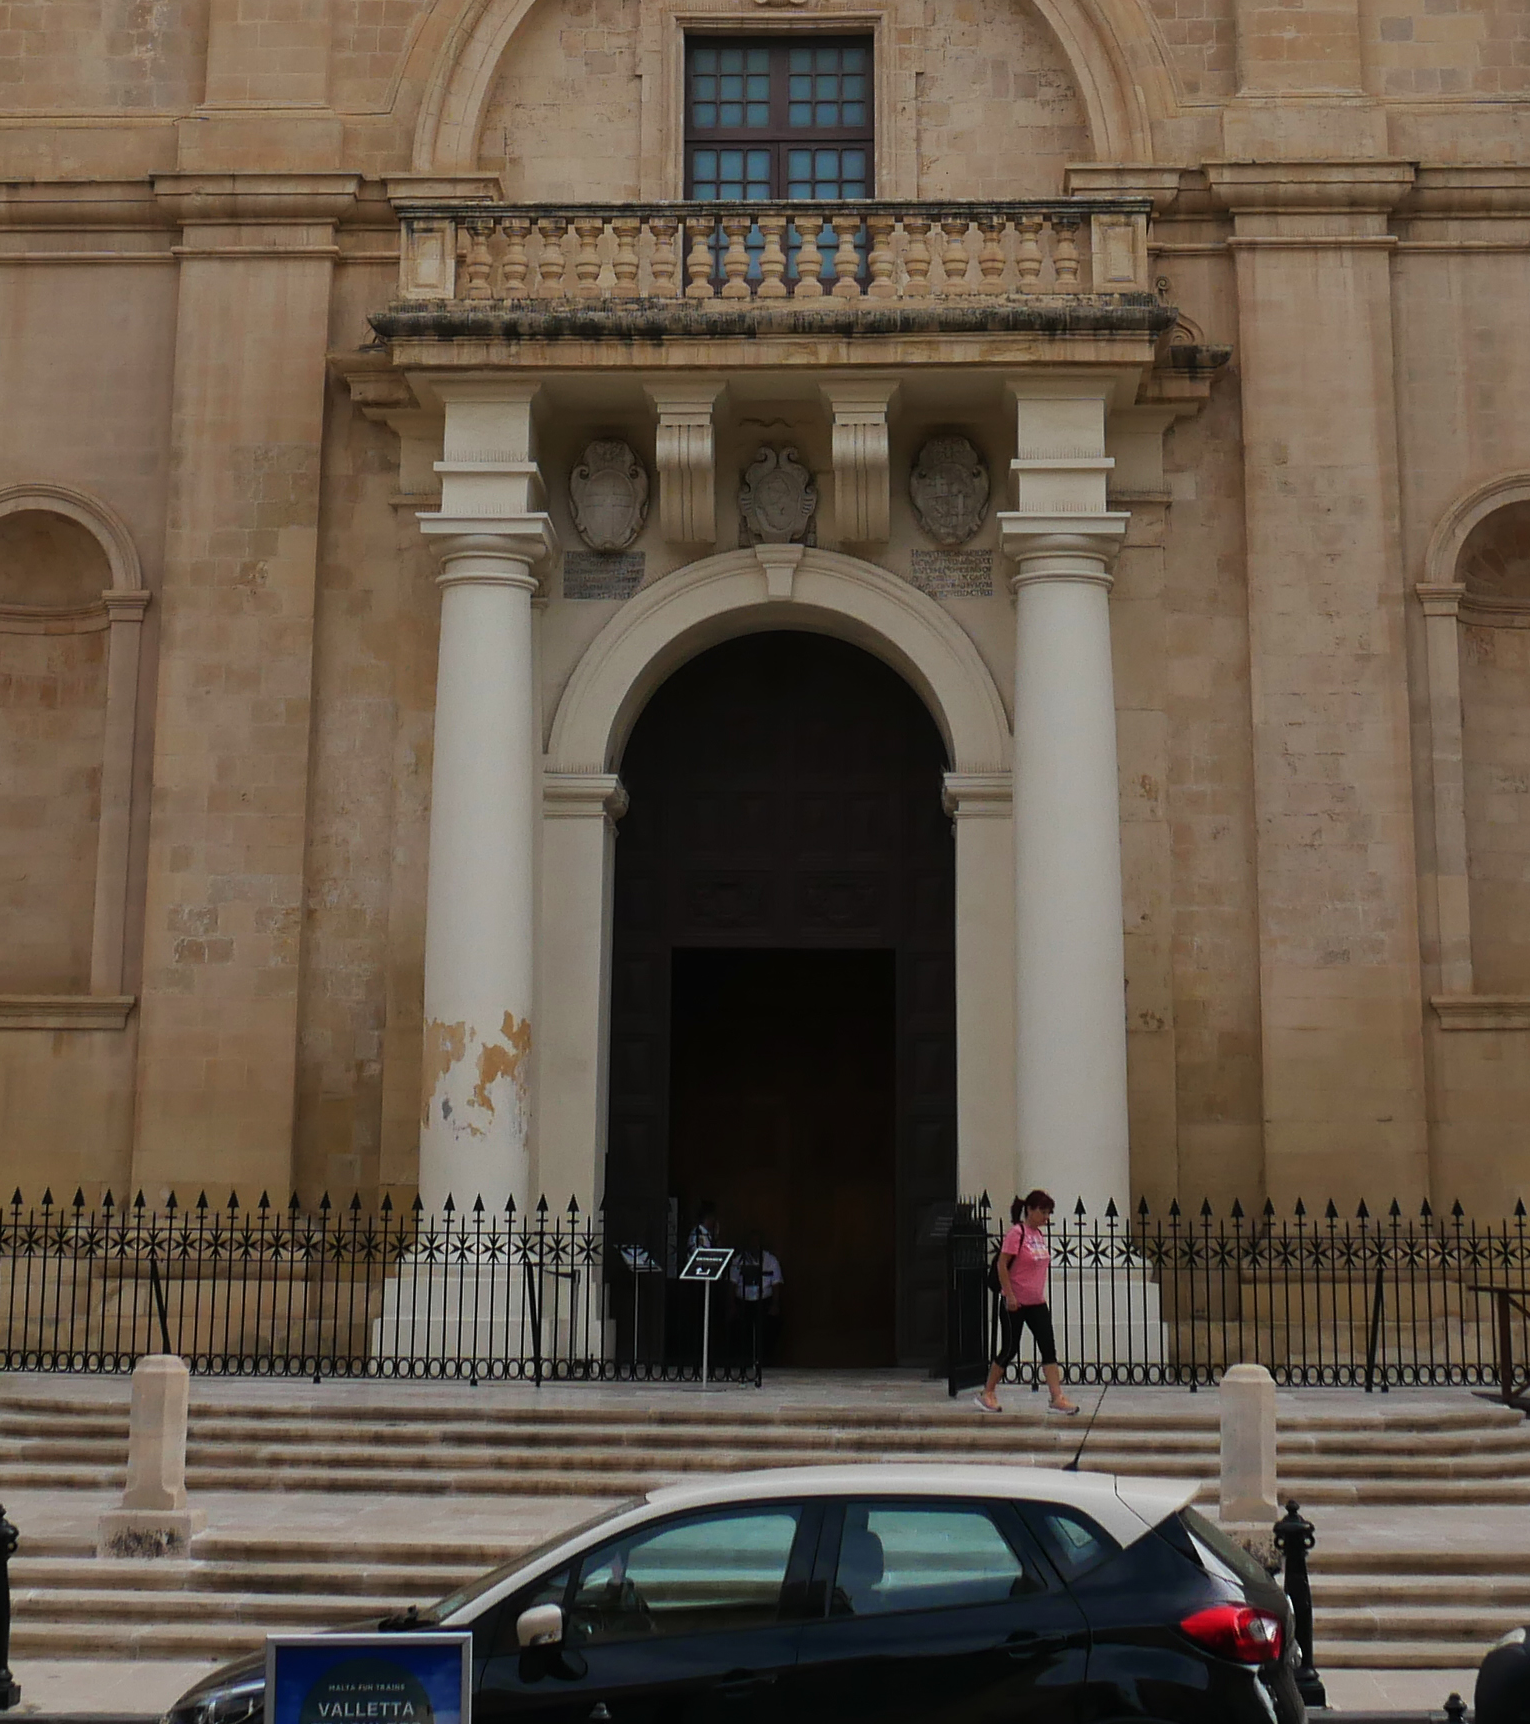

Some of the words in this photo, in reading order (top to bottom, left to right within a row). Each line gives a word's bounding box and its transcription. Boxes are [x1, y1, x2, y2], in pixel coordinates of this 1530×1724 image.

[329, 1683, 356, 1692] MALTA
[358, 1683, 373, 1692] FUN
[376, 1683, 406, 1692] TRAINS
[318, 1700, 414, 1717] VALLETTA
